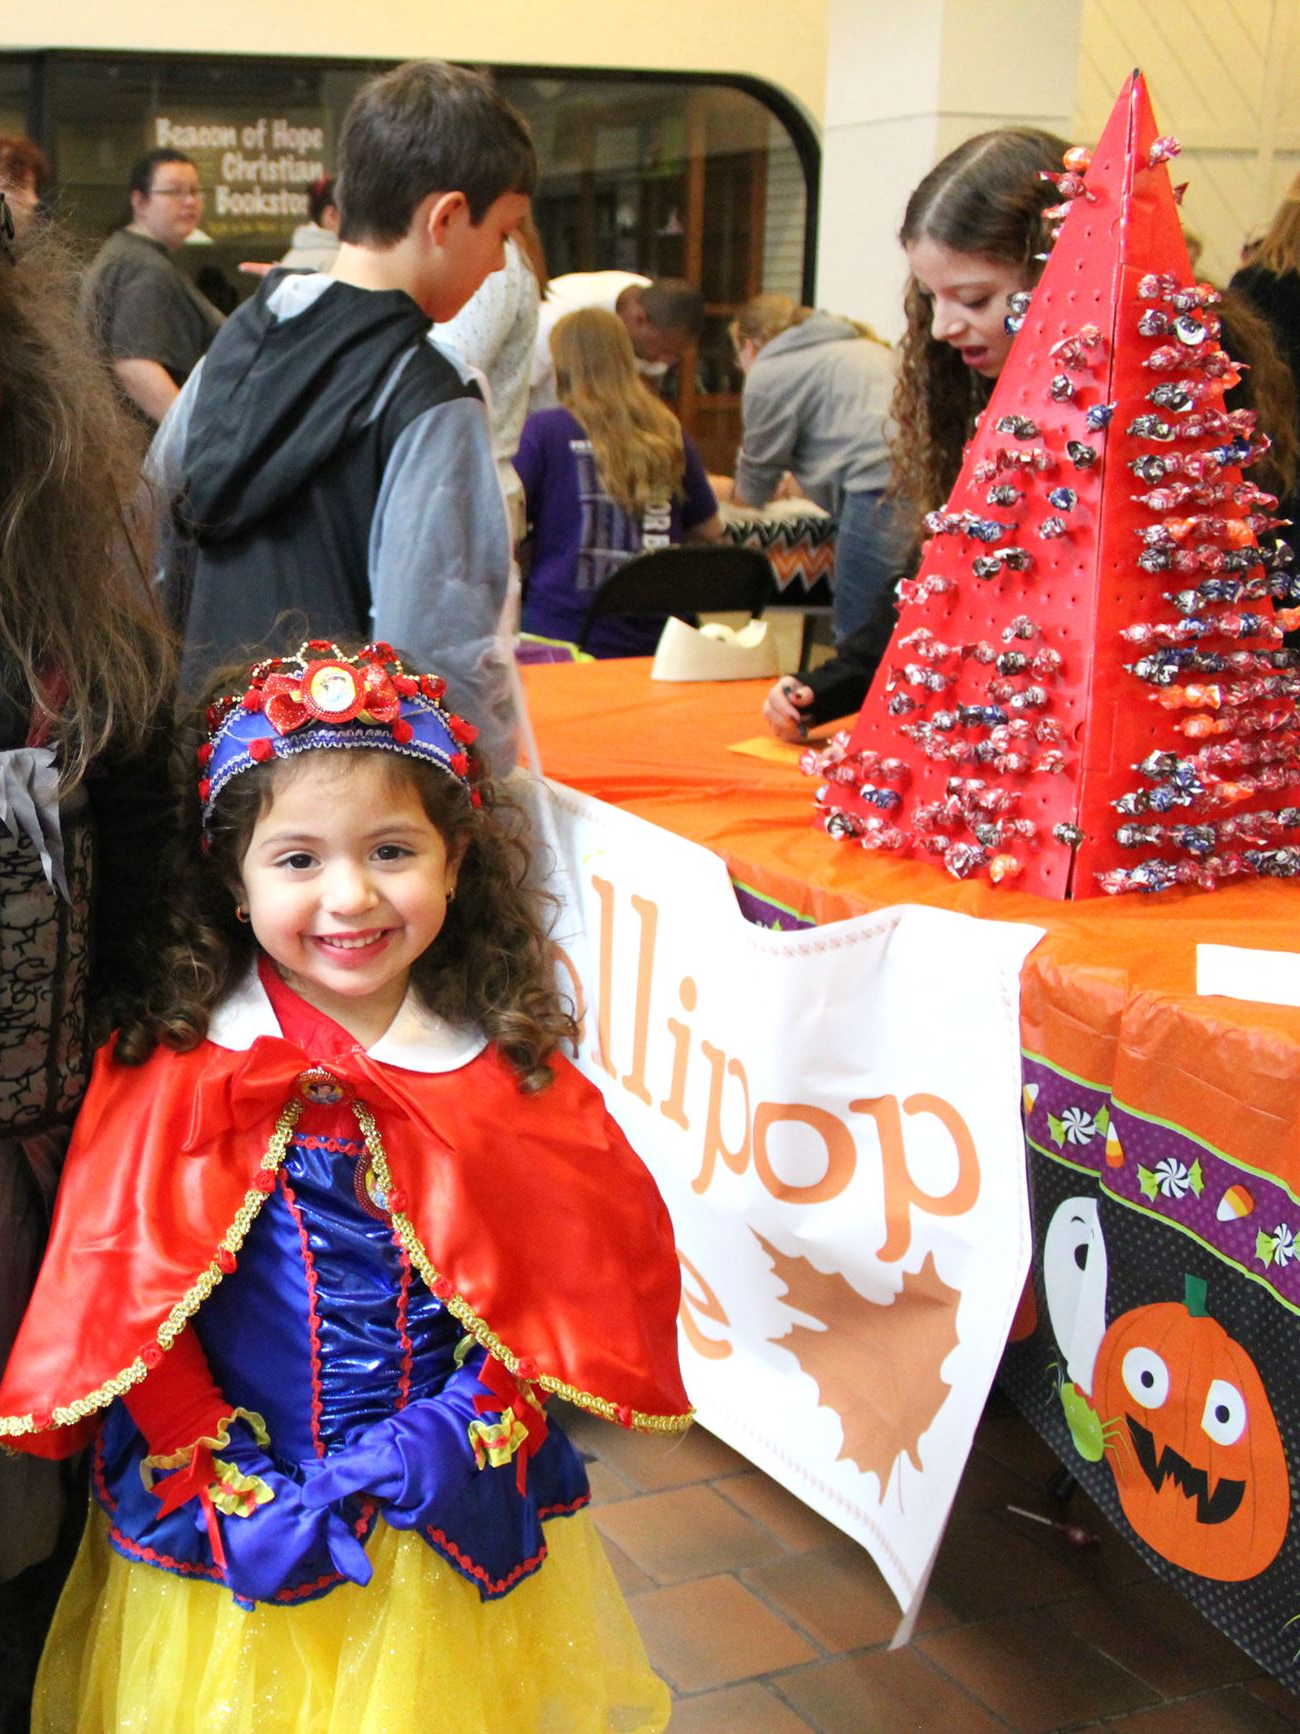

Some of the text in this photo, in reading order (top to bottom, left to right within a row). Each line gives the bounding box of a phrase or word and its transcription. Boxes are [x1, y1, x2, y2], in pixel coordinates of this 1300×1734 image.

[241, 118, 267, 148] of
[272, 118, 324, 154] Hope
[221, 151, 324, 182] Christian
[215, 184, 309, 215] Bookstor
